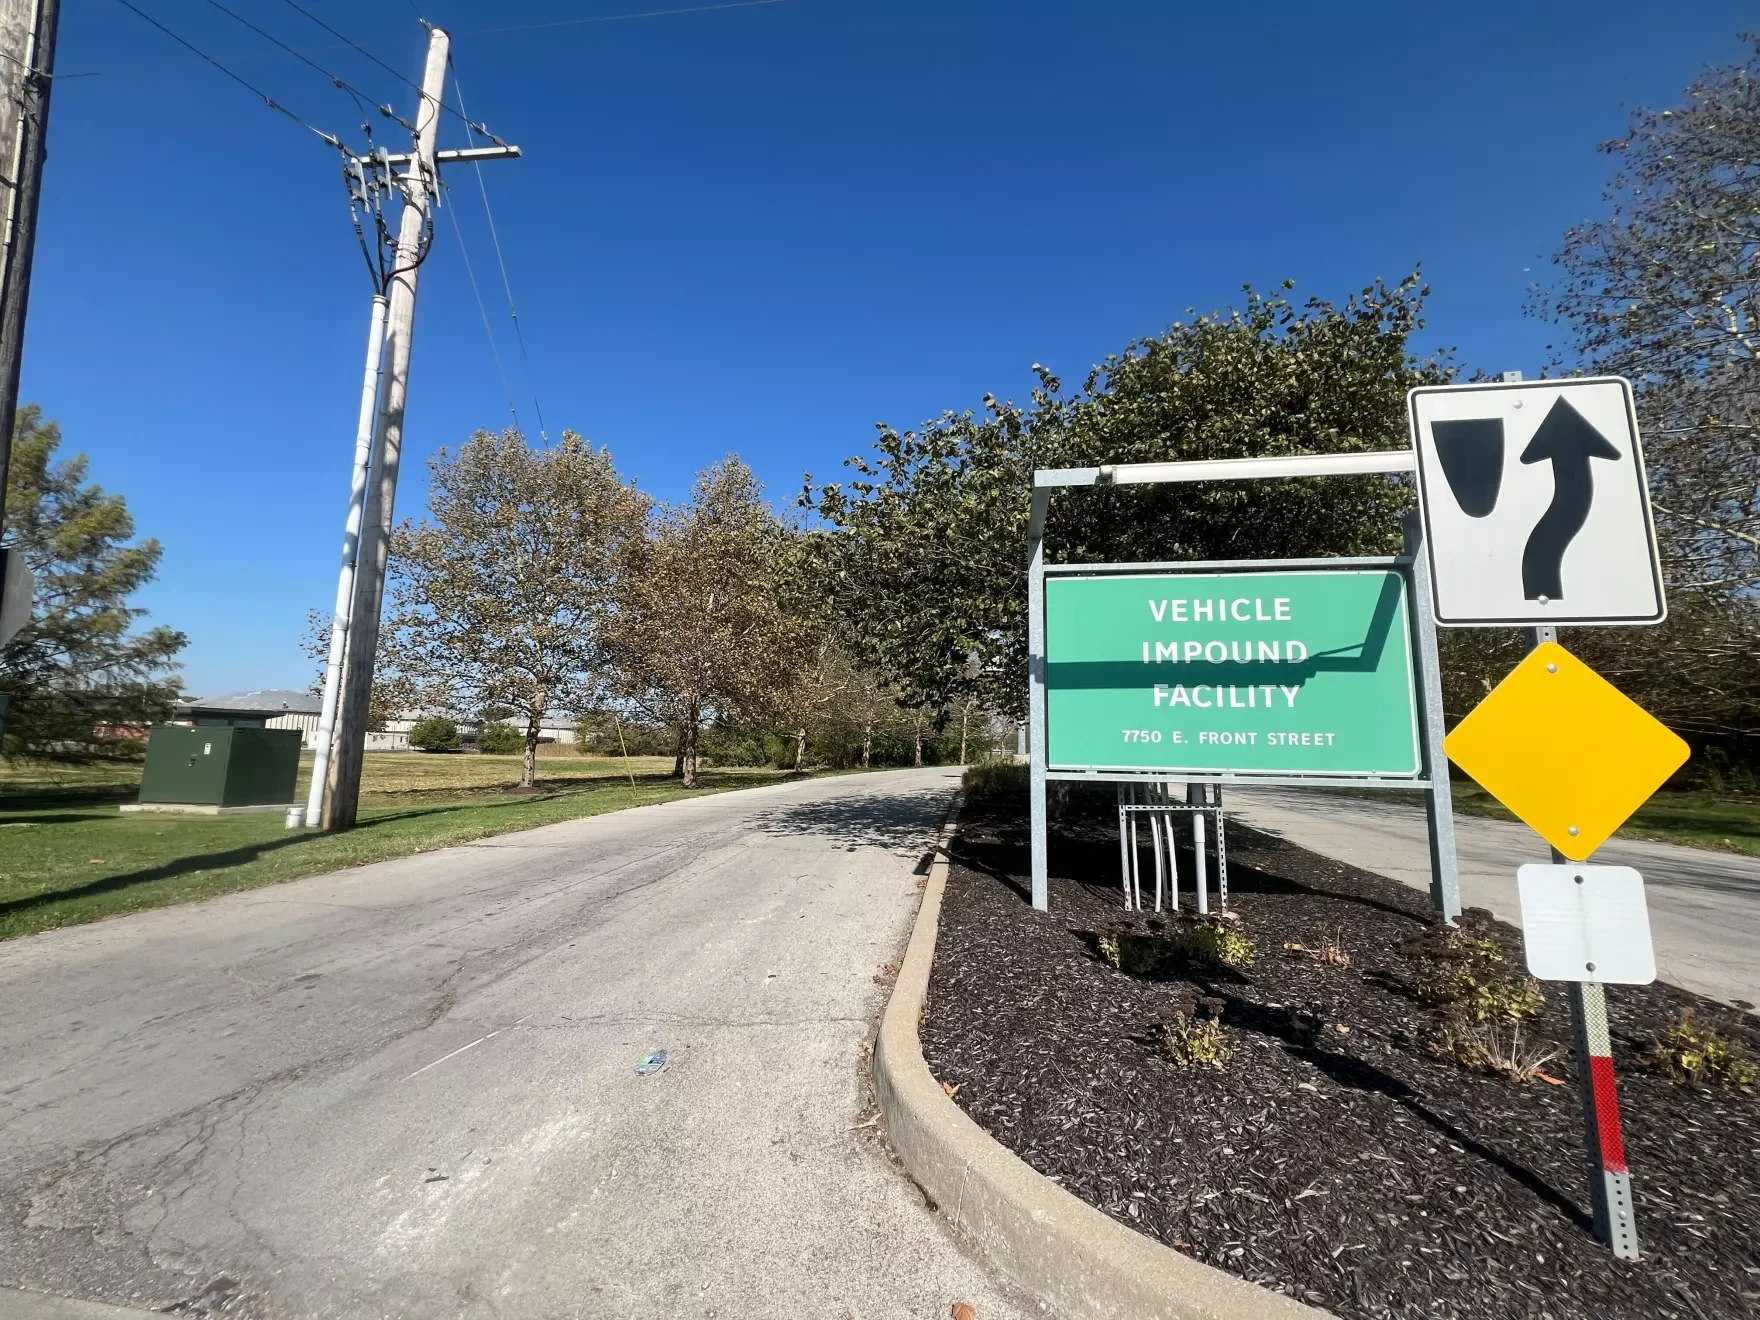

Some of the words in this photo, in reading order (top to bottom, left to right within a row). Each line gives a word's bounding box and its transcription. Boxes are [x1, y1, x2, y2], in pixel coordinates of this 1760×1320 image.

[1148, 598, 1292, 622] VEHICLE
[1142, 640, 1307, 664] IMPOUND
[1153, 684, 1300, 708] FACILITY
[1121, 730, 1162, 744] 7750
[1172, 731, 1189, 744] E.
[1199, 731, 1258, 745] FRONT
[1267, 732, 1336, 746] STREET
